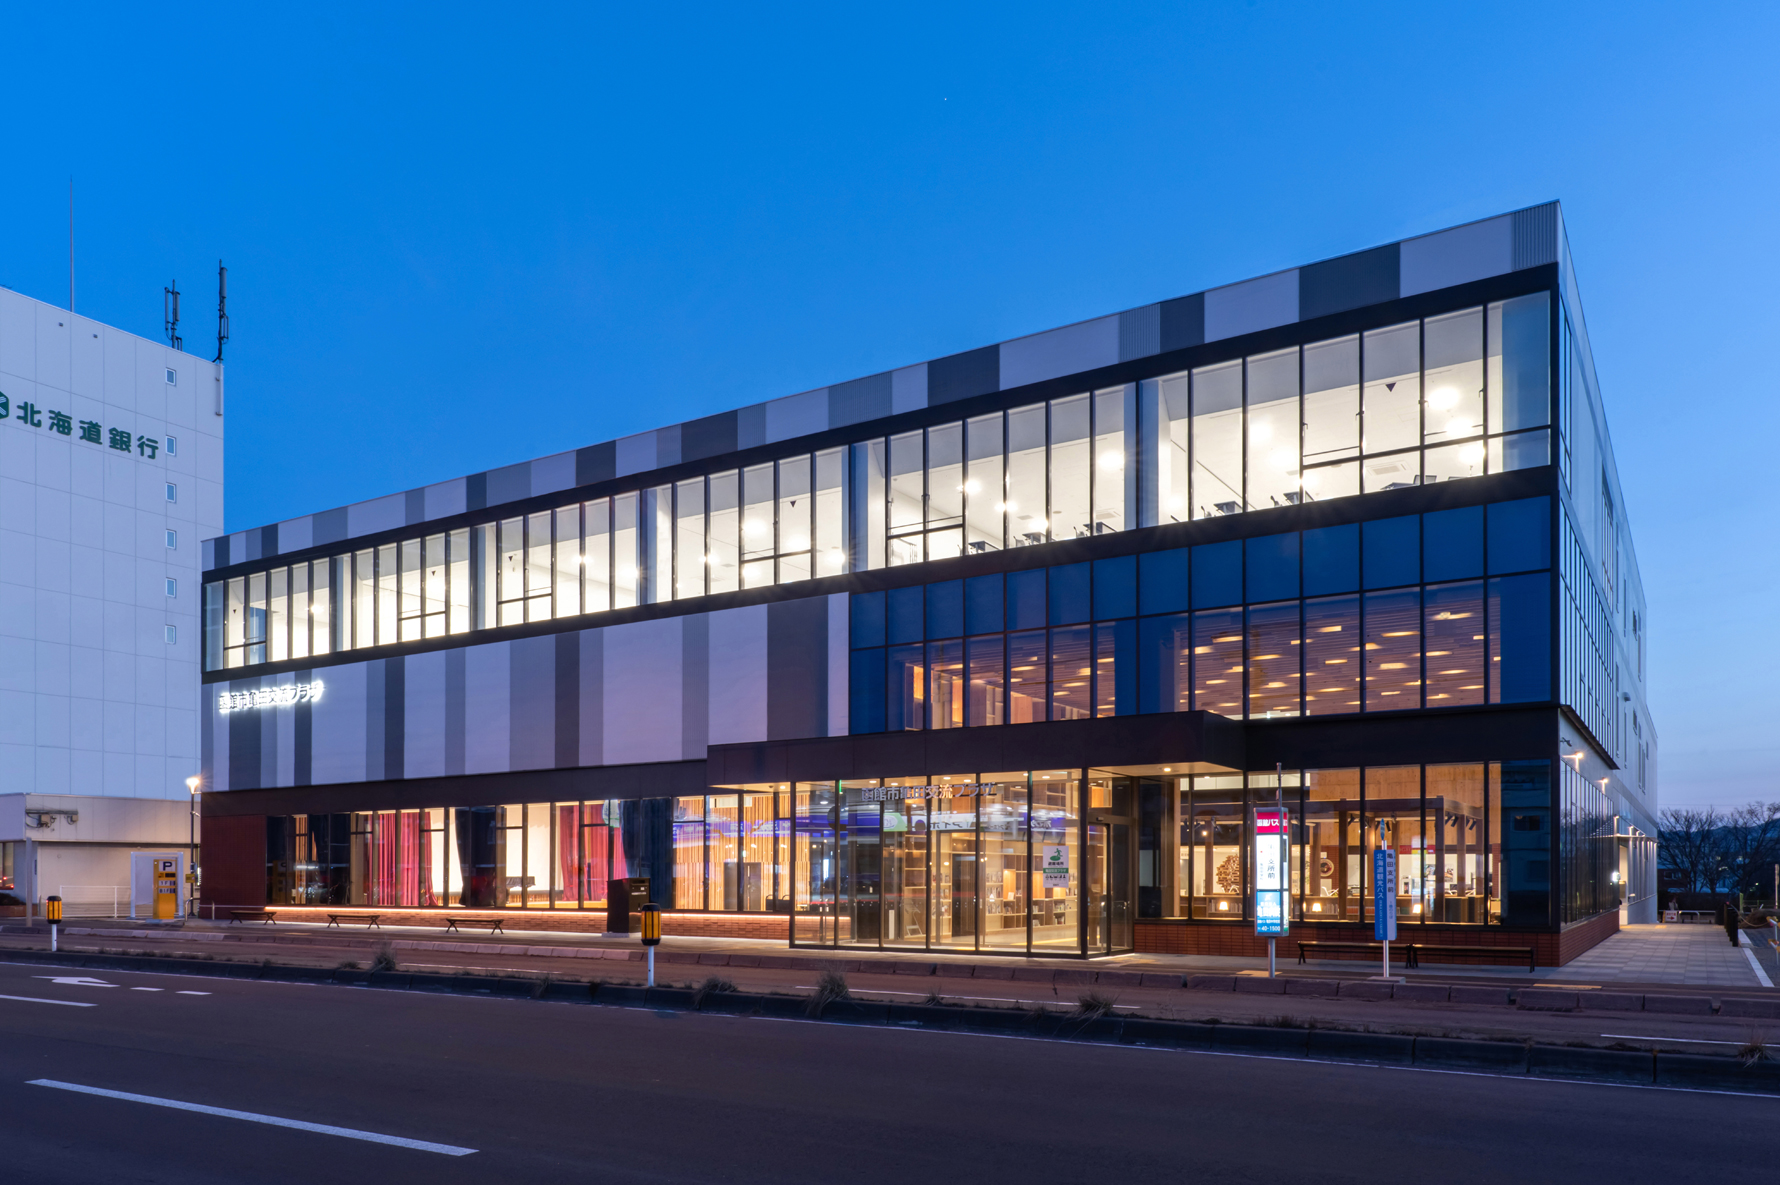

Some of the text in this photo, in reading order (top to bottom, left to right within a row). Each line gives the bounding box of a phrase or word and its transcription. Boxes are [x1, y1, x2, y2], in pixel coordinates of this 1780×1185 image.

[16, 401, 159, 460] 北海道銀行
[861, 782, 995, 801] 函館市亀田交流プラザ
[163, 861, 172, 871] P
[1386, 853, 1394, 893] 亀田支所前
